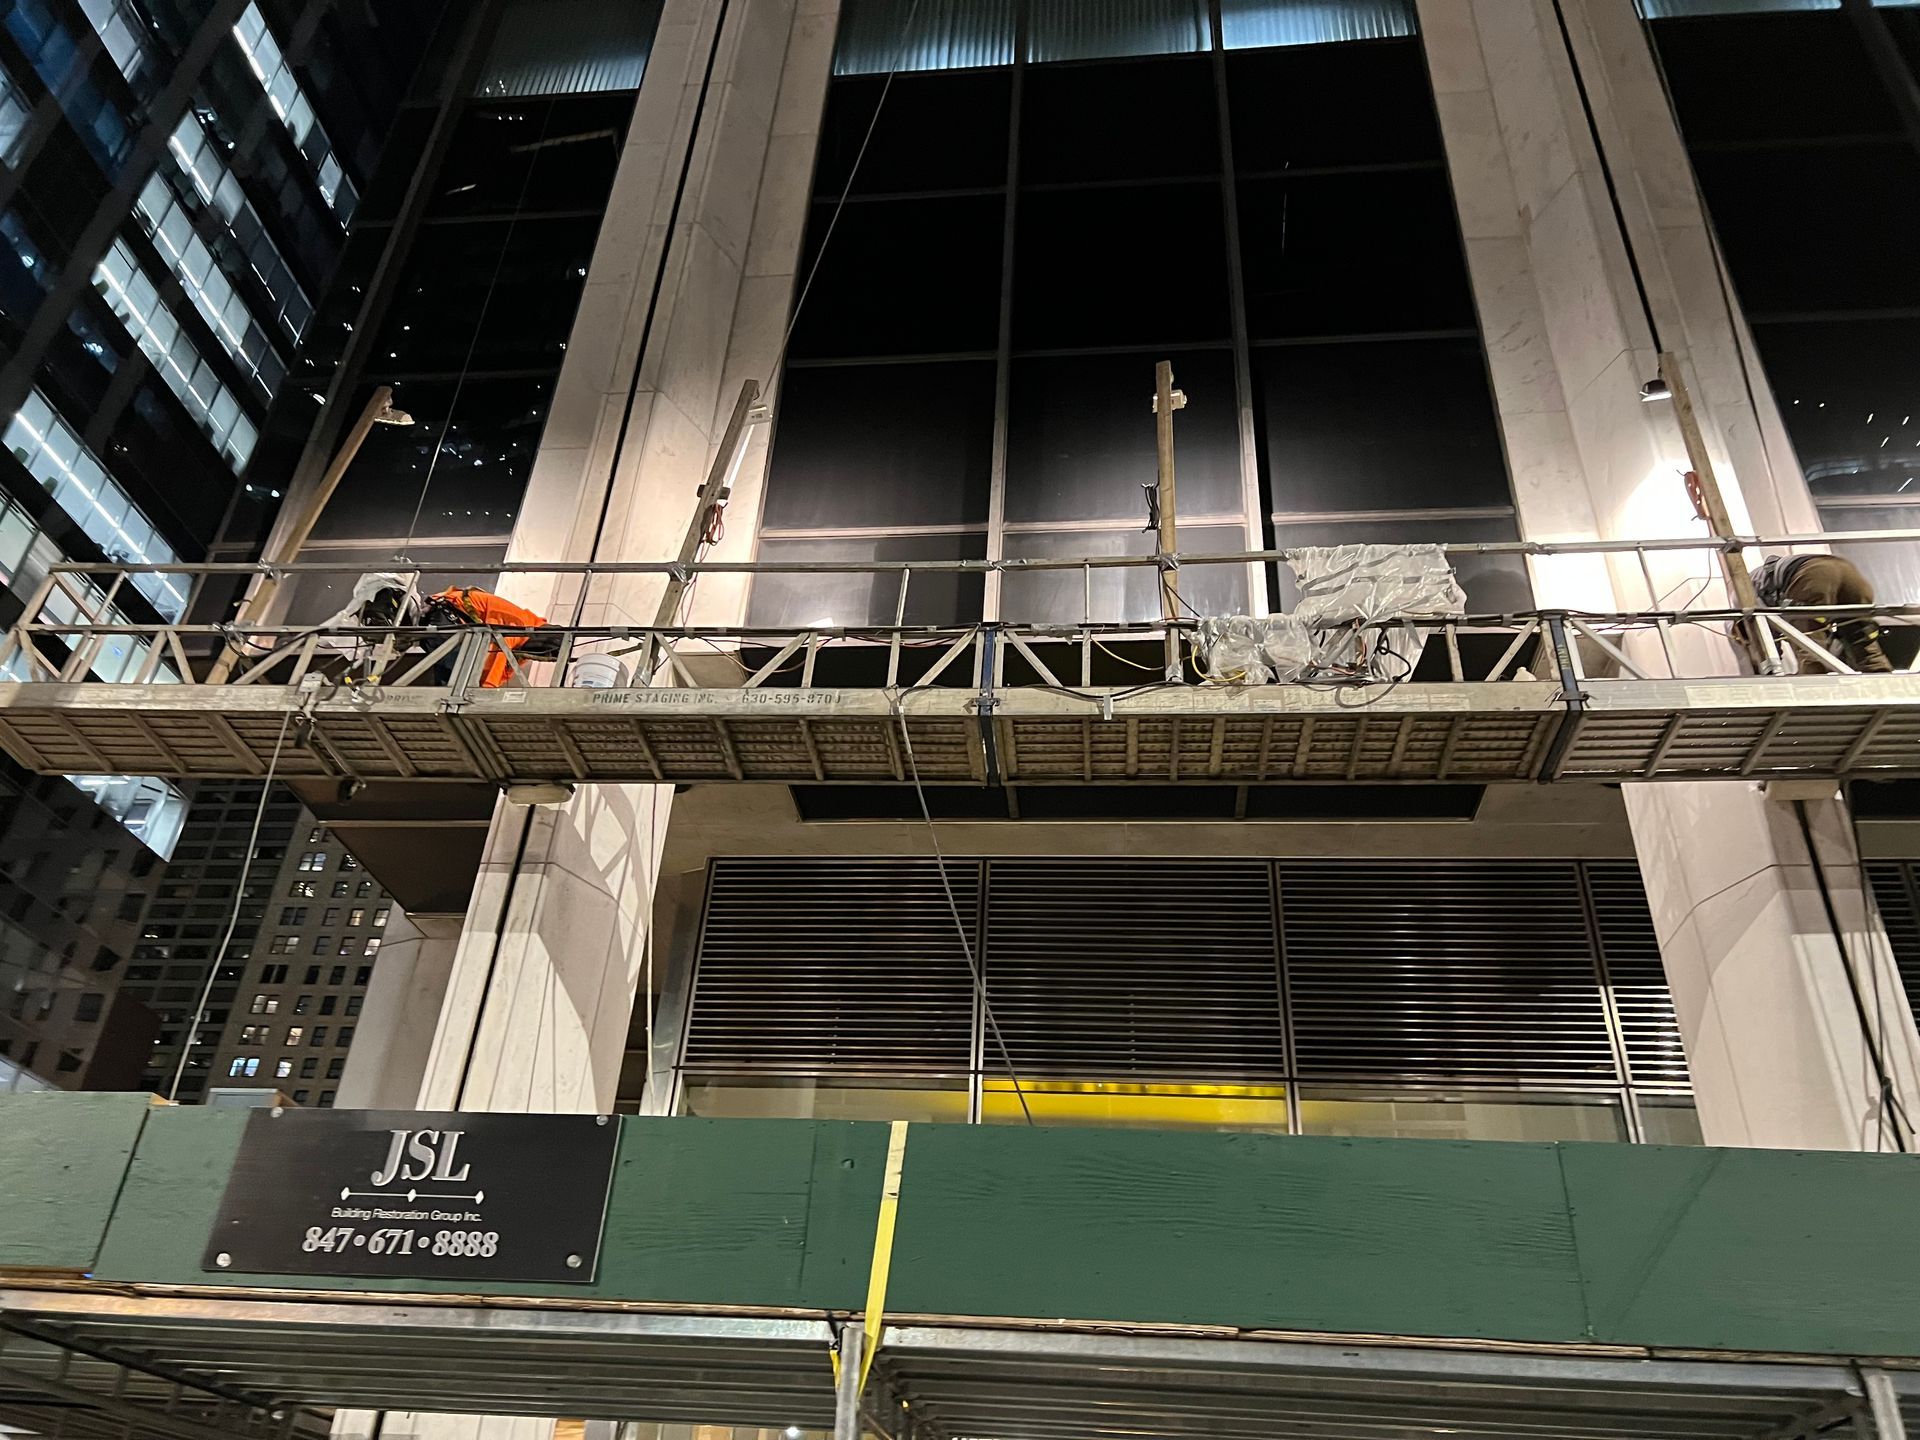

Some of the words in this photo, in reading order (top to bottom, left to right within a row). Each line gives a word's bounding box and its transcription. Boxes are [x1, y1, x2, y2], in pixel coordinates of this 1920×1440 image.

[592, 693, 631, 704] PRIME
[635, 693, 689, 704] STAGING
[370, 1129, 471, 1187] JSL
[331, 1207, 372, 1221] Building
[372, 1208, 429, 1221] Restoration
[430, 1210, 462, 1223] Group
[463, 1211, 483, 1222] Inc.
